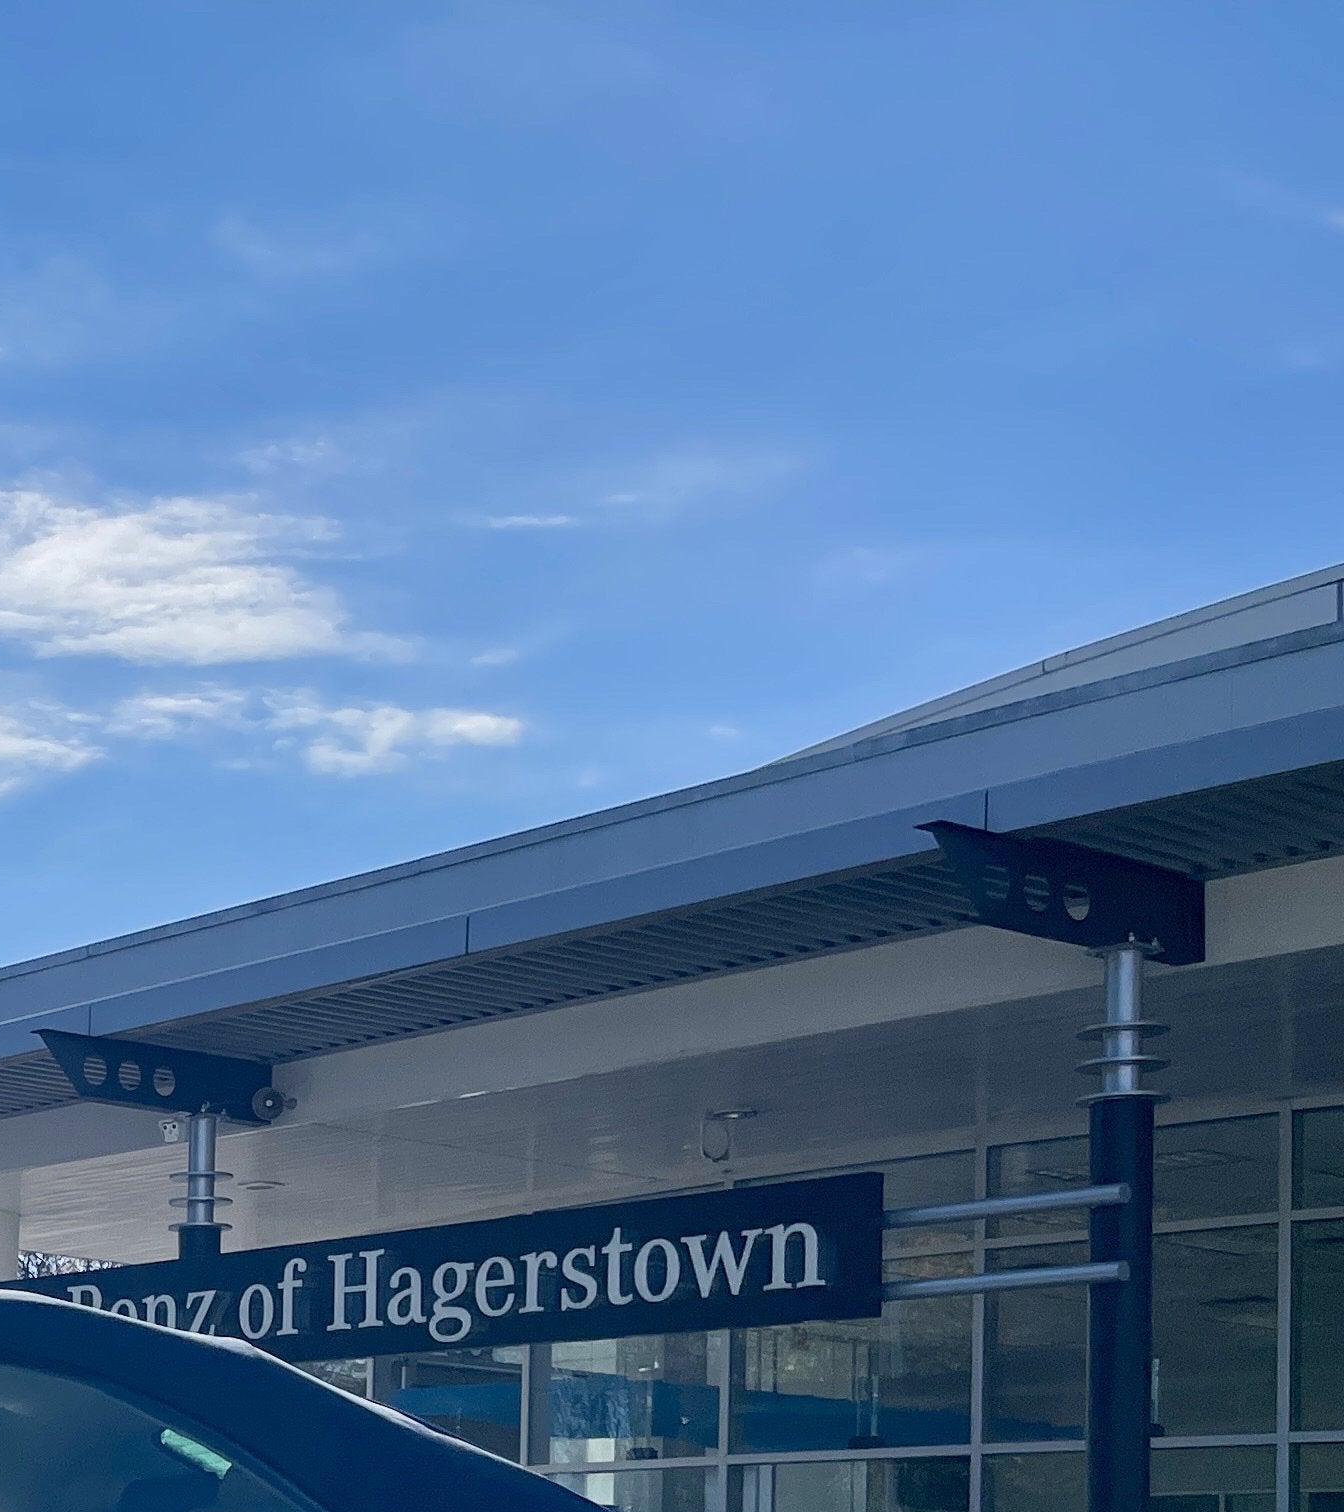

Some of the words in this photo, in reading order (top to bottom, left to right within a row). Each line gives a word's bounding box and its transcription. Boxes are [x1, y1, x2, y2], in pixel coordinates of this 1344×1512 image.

[67, 1284, 217, 1336] nz
[238, 1257, 308, 1341] of
[325, 1221, 827, 1343] Hagerstown
